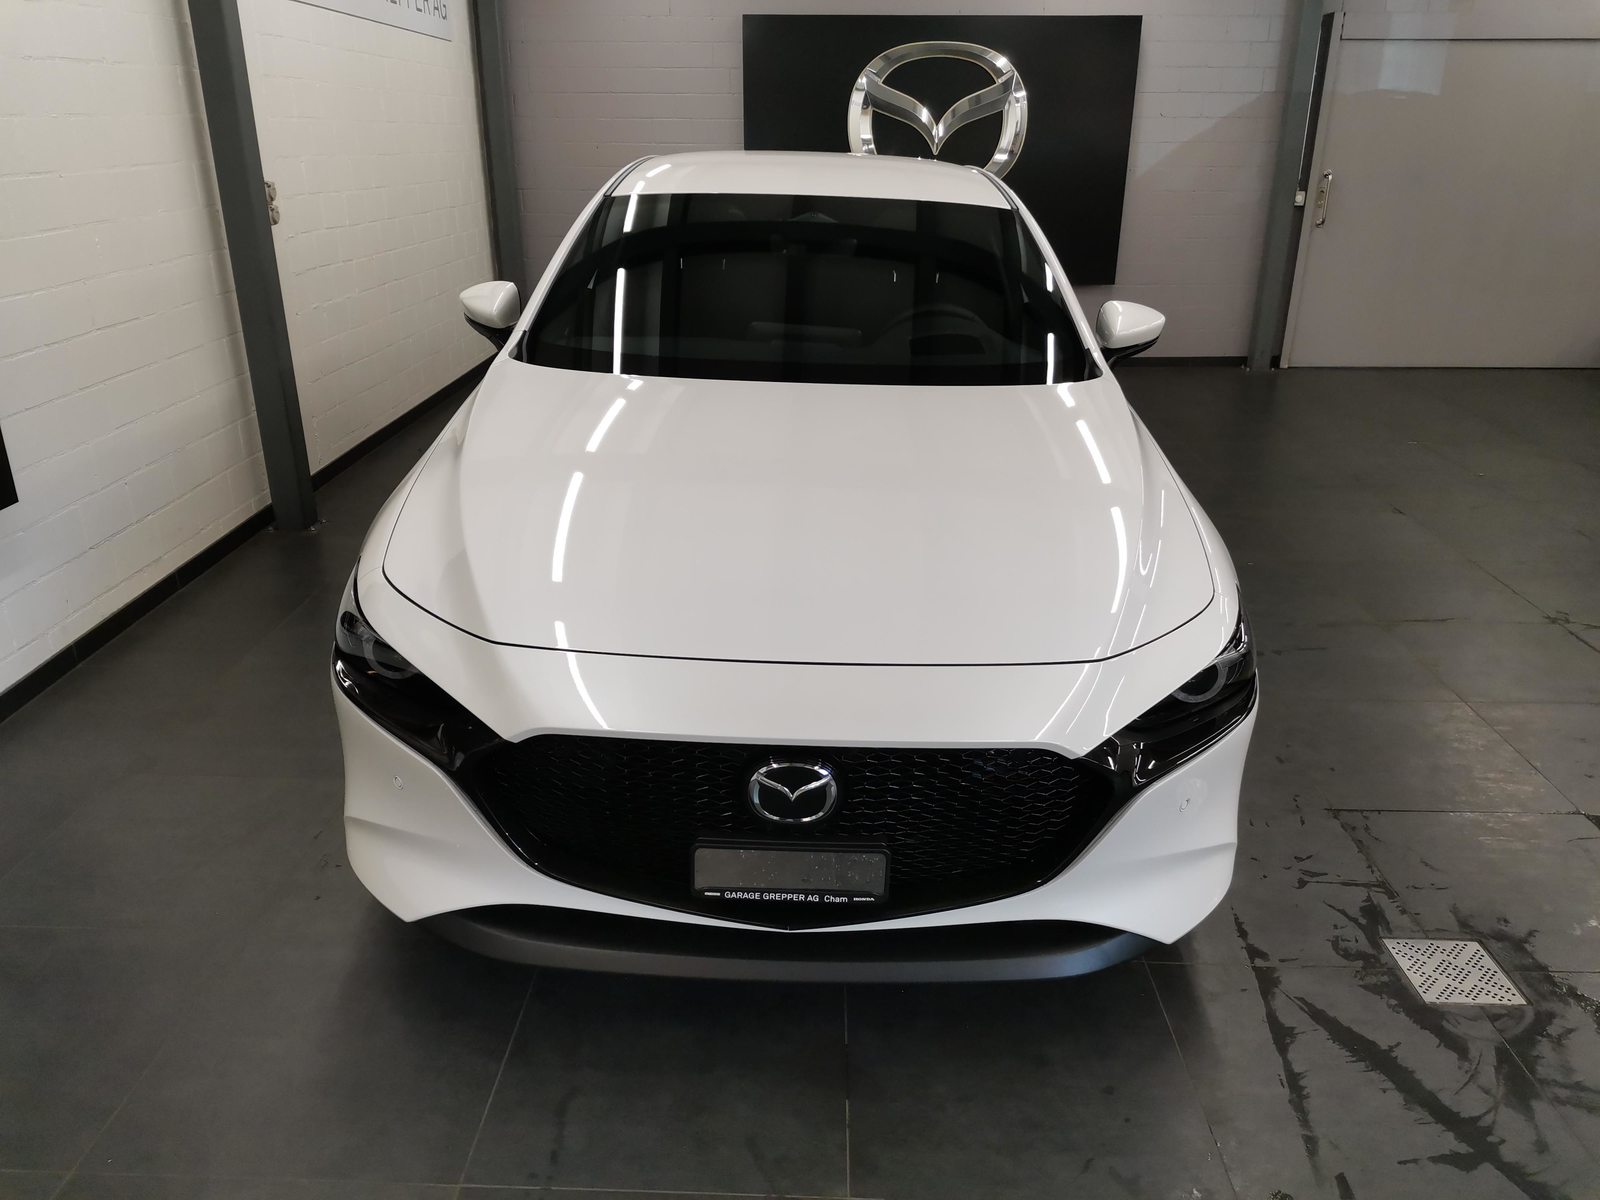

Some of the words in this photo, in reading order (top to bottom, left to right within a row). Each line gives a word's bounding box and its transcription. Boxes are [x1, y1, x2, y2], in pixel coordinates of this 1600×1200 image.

[724, 891, 761, 900] GARAGE
[763, 892, 805, 902] GREPPER
[806, 894, 819, 902] AG
[824, 895, 848, 903] Cham
